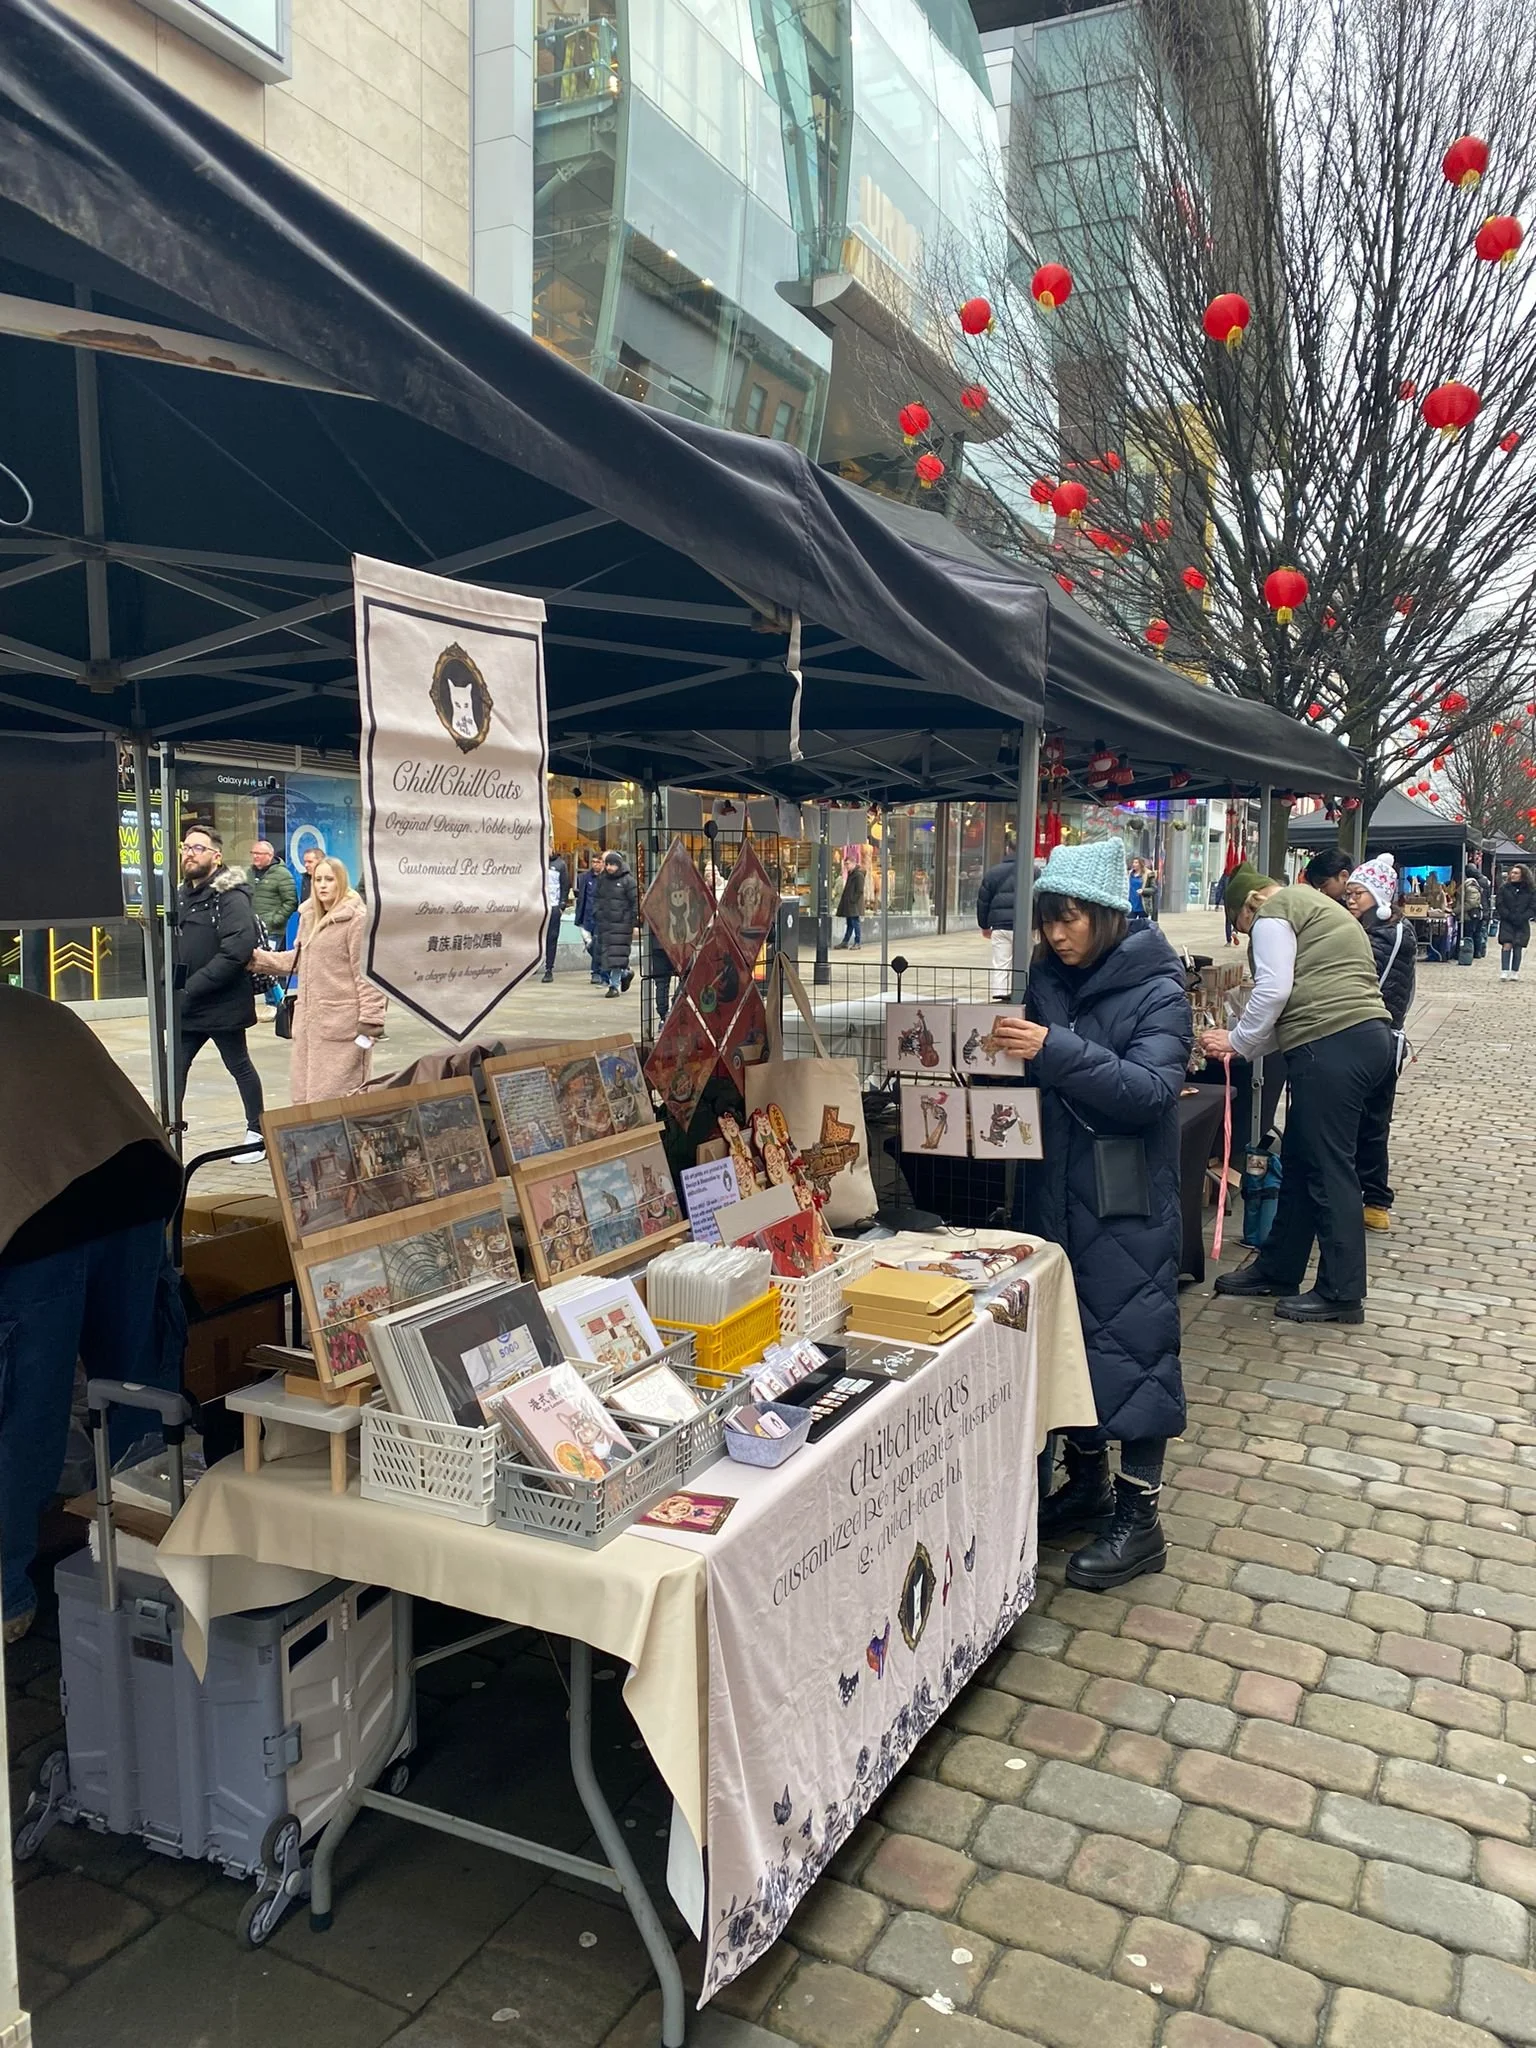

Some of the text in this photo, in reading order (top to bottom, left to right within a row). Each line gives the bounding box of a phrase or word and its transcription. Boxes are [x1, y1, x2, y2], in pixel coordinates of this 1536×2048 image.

[217, 774, 241, 786] Galaxy
[393, 760, 522, 799] ChillChillCats
[119, 826, 164, 850] WN
[385, 812, 433, 837] Original
[475, 817, 507, 835] Noble
[507, 818, 533, 840] Style
[398, 856, 523, 876] Customised Pet Portrait
